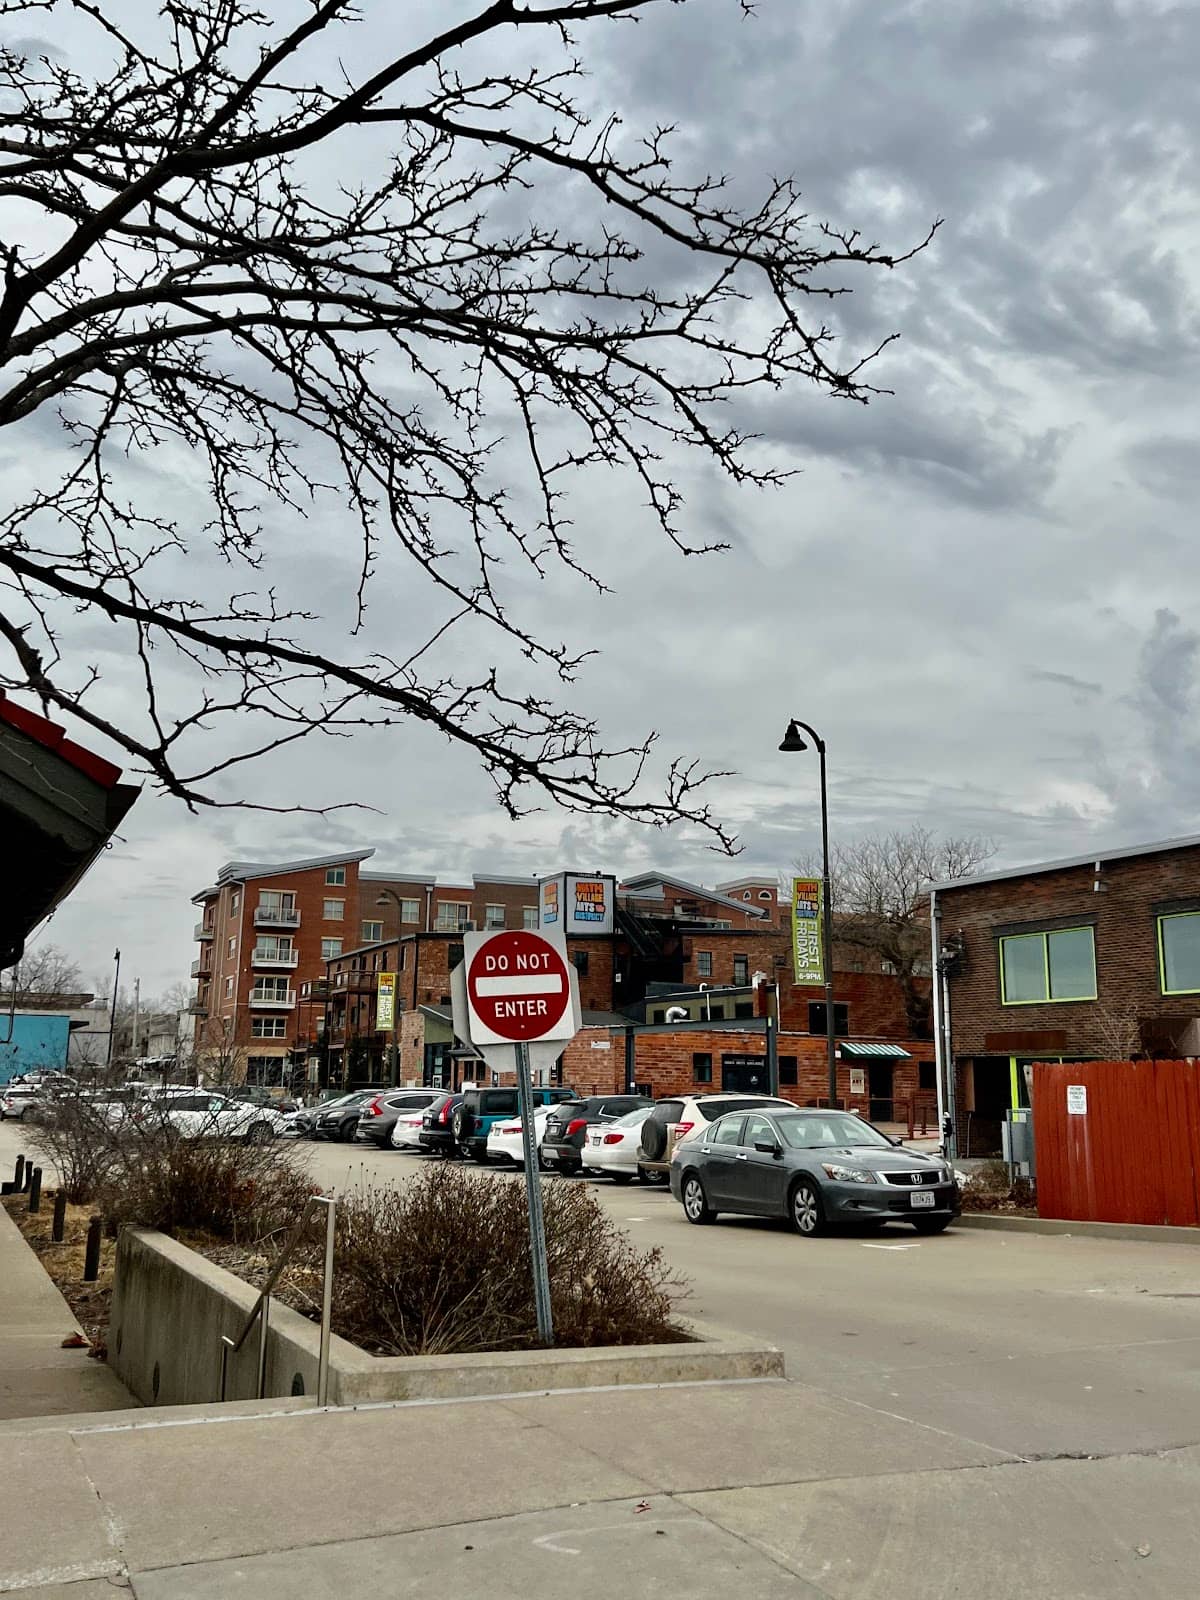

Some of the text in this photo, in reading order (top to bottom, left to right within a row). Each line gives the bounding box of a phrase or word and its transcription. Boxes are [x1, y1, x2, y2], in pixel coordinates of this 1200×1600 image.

[797, 920, 809, 968] FRIDAYS
[808, 921, 819, 965] FIRST
[485, 953, 550, 971] DO NOT
[494, 1000, 547, 1017] ENTER
